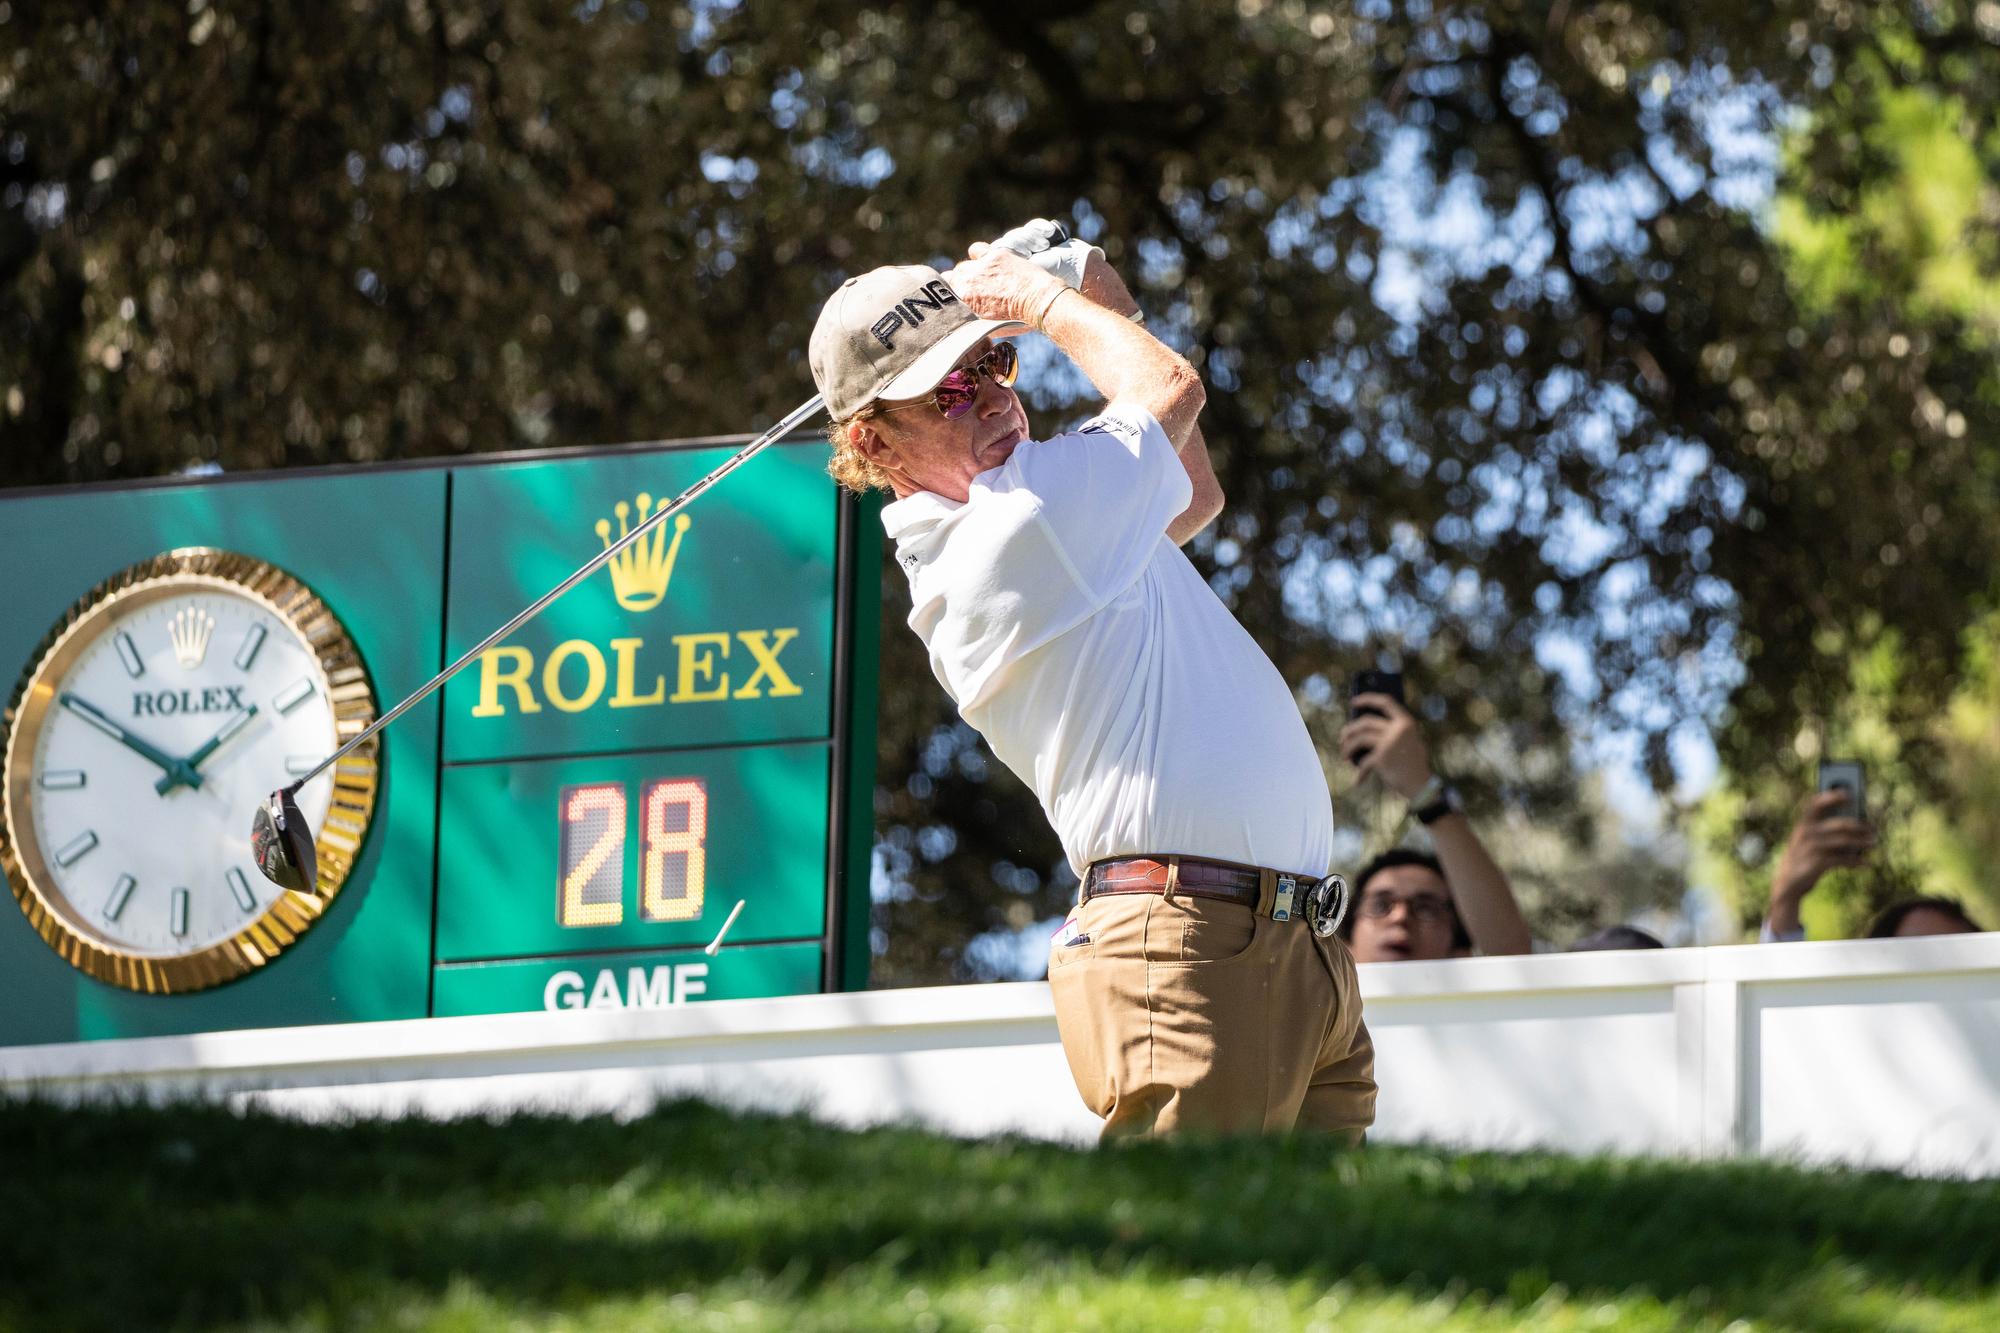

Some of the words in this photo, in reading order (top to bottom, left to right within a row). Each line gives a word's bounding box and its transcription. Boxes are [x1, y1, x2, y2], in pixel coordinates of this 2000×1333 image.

[870, 280, 958, 351] PING
[133, 686, 244, 716] ROLEX
[471, 628, 803, 718] ROLEX
[563, 782, 707, 926] 28
[544, 963, 709, 1012] GAME
